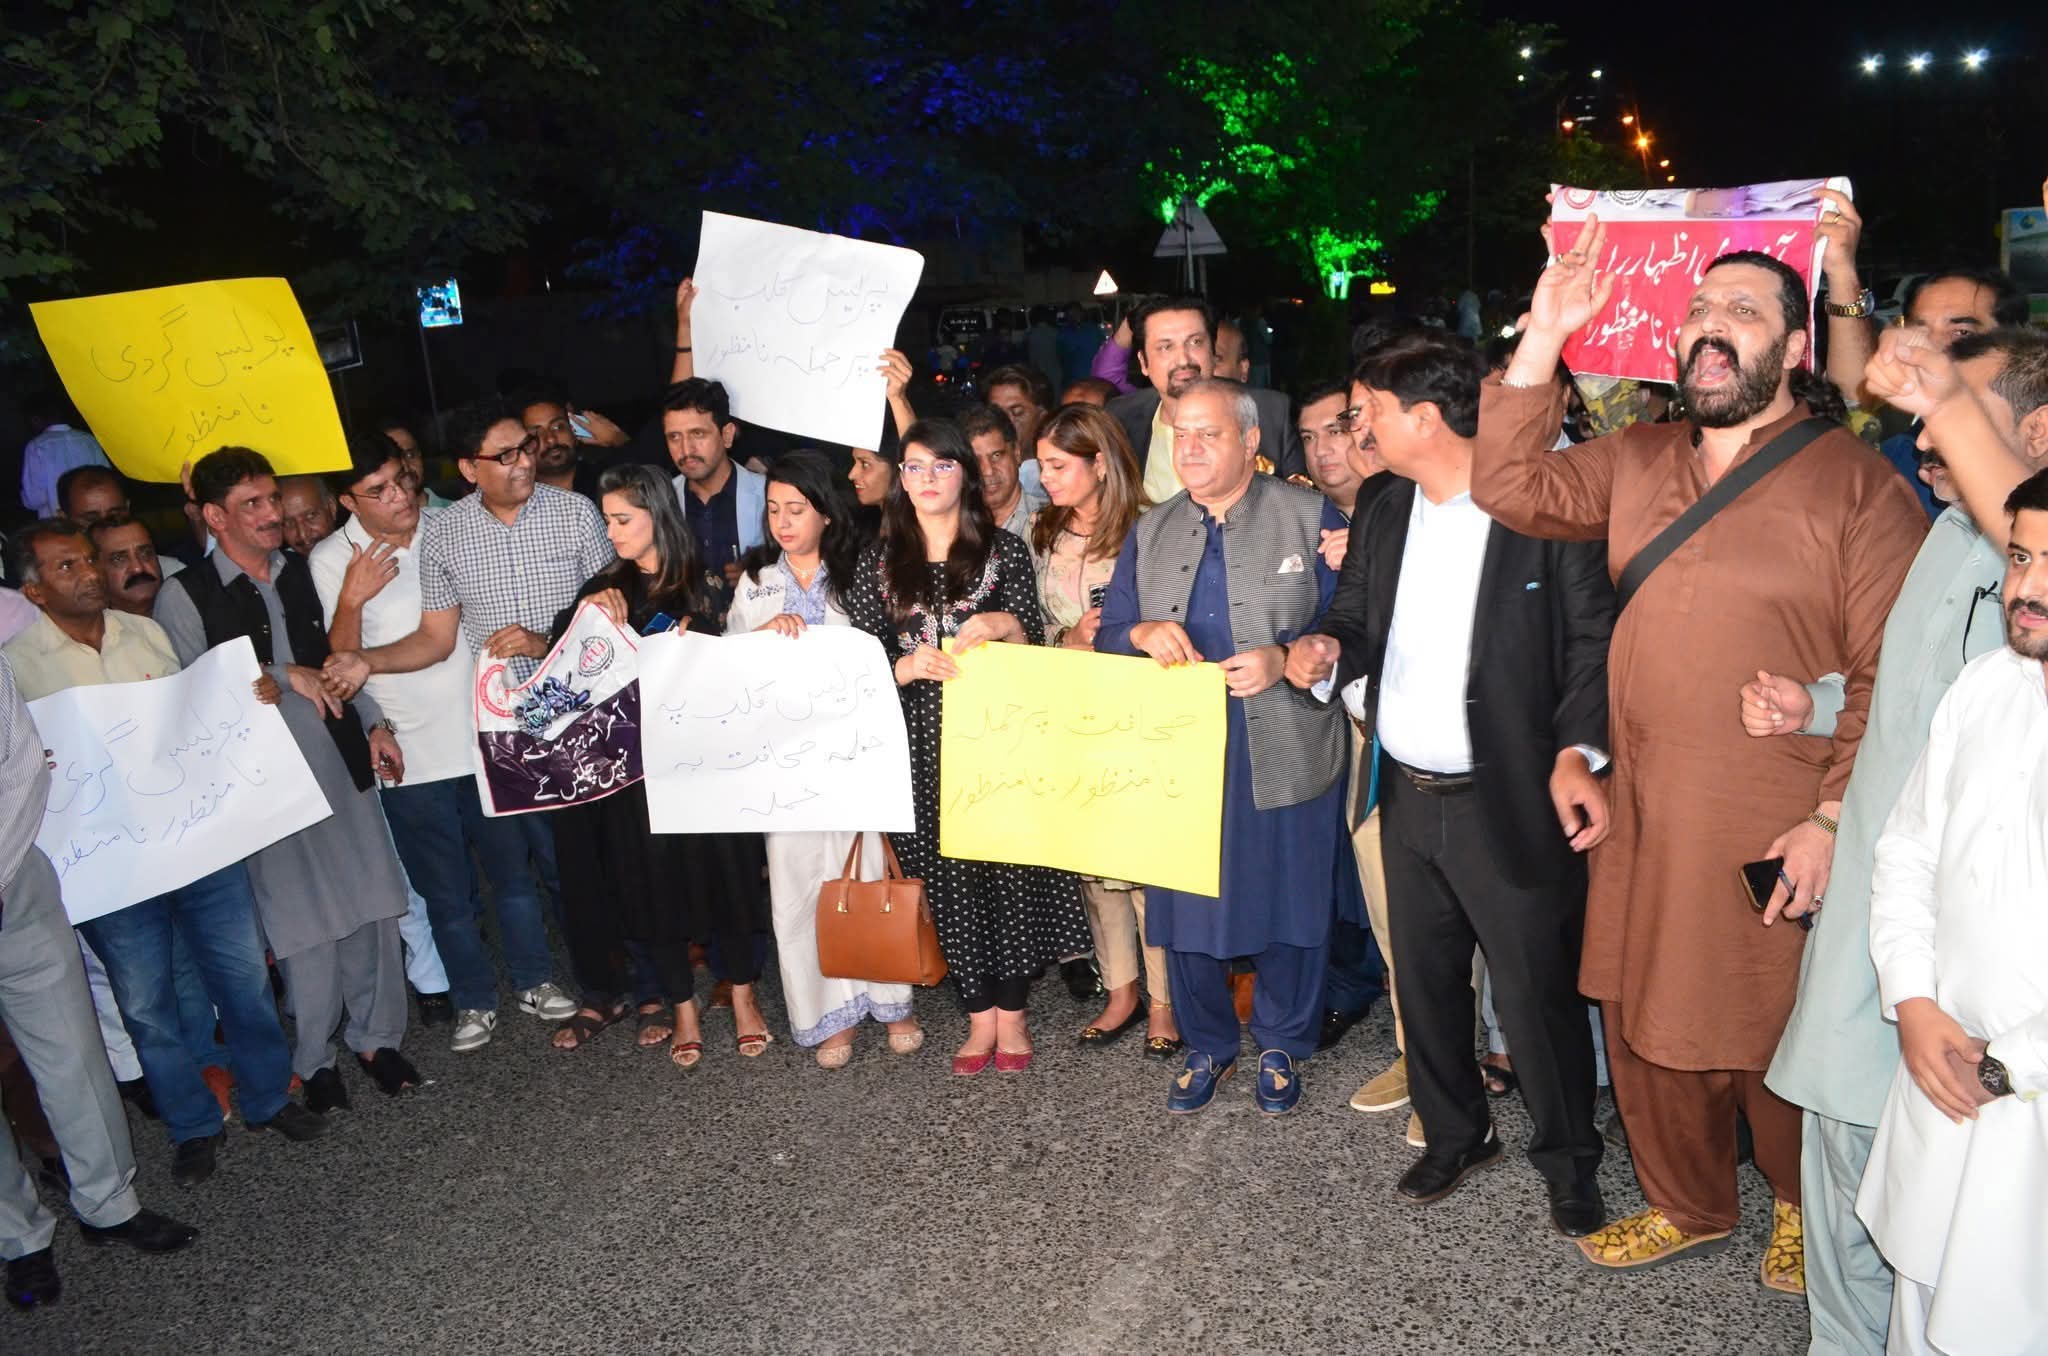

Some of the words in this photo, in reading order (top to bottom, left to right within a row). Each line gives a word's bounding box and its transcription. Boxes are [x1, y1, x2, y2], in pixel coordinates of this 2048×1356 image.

[90, 303, 189, 392] گردی
[185, 307, 294, 387] پولیس
[695, 680, 776, 725] کلب
[951, 703, 1024, 741] حملہ
[1065, 703, 1197, 742] صحافت
[126, 687, 251, 797] پولیس
[46, 718, 141, 817] گردی
[534, 775, 560, 801] گے
[599, 748, 628, 790] نہیں
